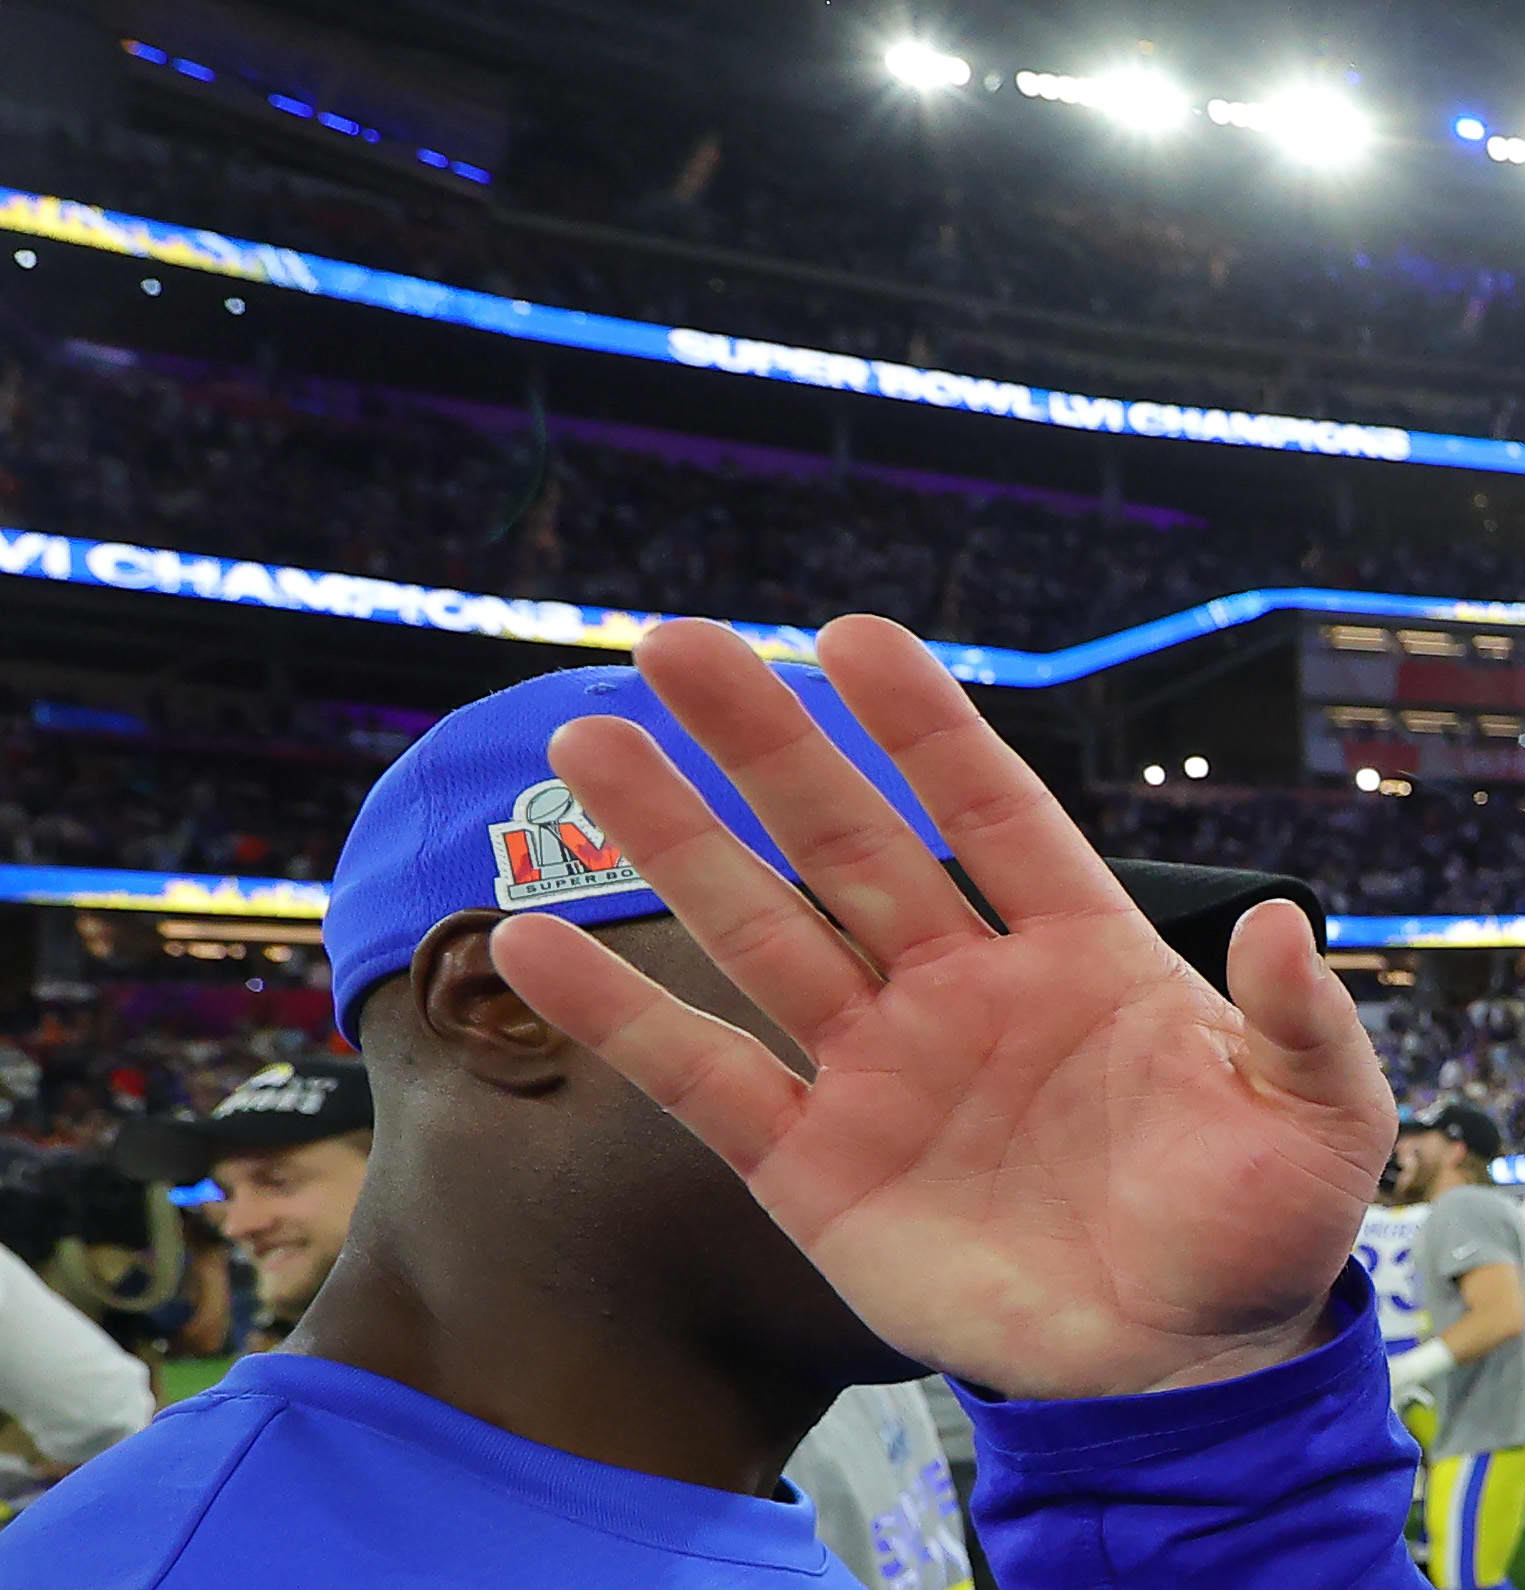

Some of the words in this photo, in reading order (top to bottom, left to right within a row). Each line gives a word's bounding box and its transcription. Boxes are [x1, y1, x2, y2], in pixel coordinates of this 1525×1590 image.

[667, 326, 869, 391] SUPER
[873, 360, 1042, 422] BOWL
[1048, 390, 1124, 433] LVI
[1127, 401, 1411, 462] CHAMPIONS
[86, 542, 585, 644] CHAMPIONS
[526, 873, 596, 894] SUPER
[605, 867, 634, 881] BO
